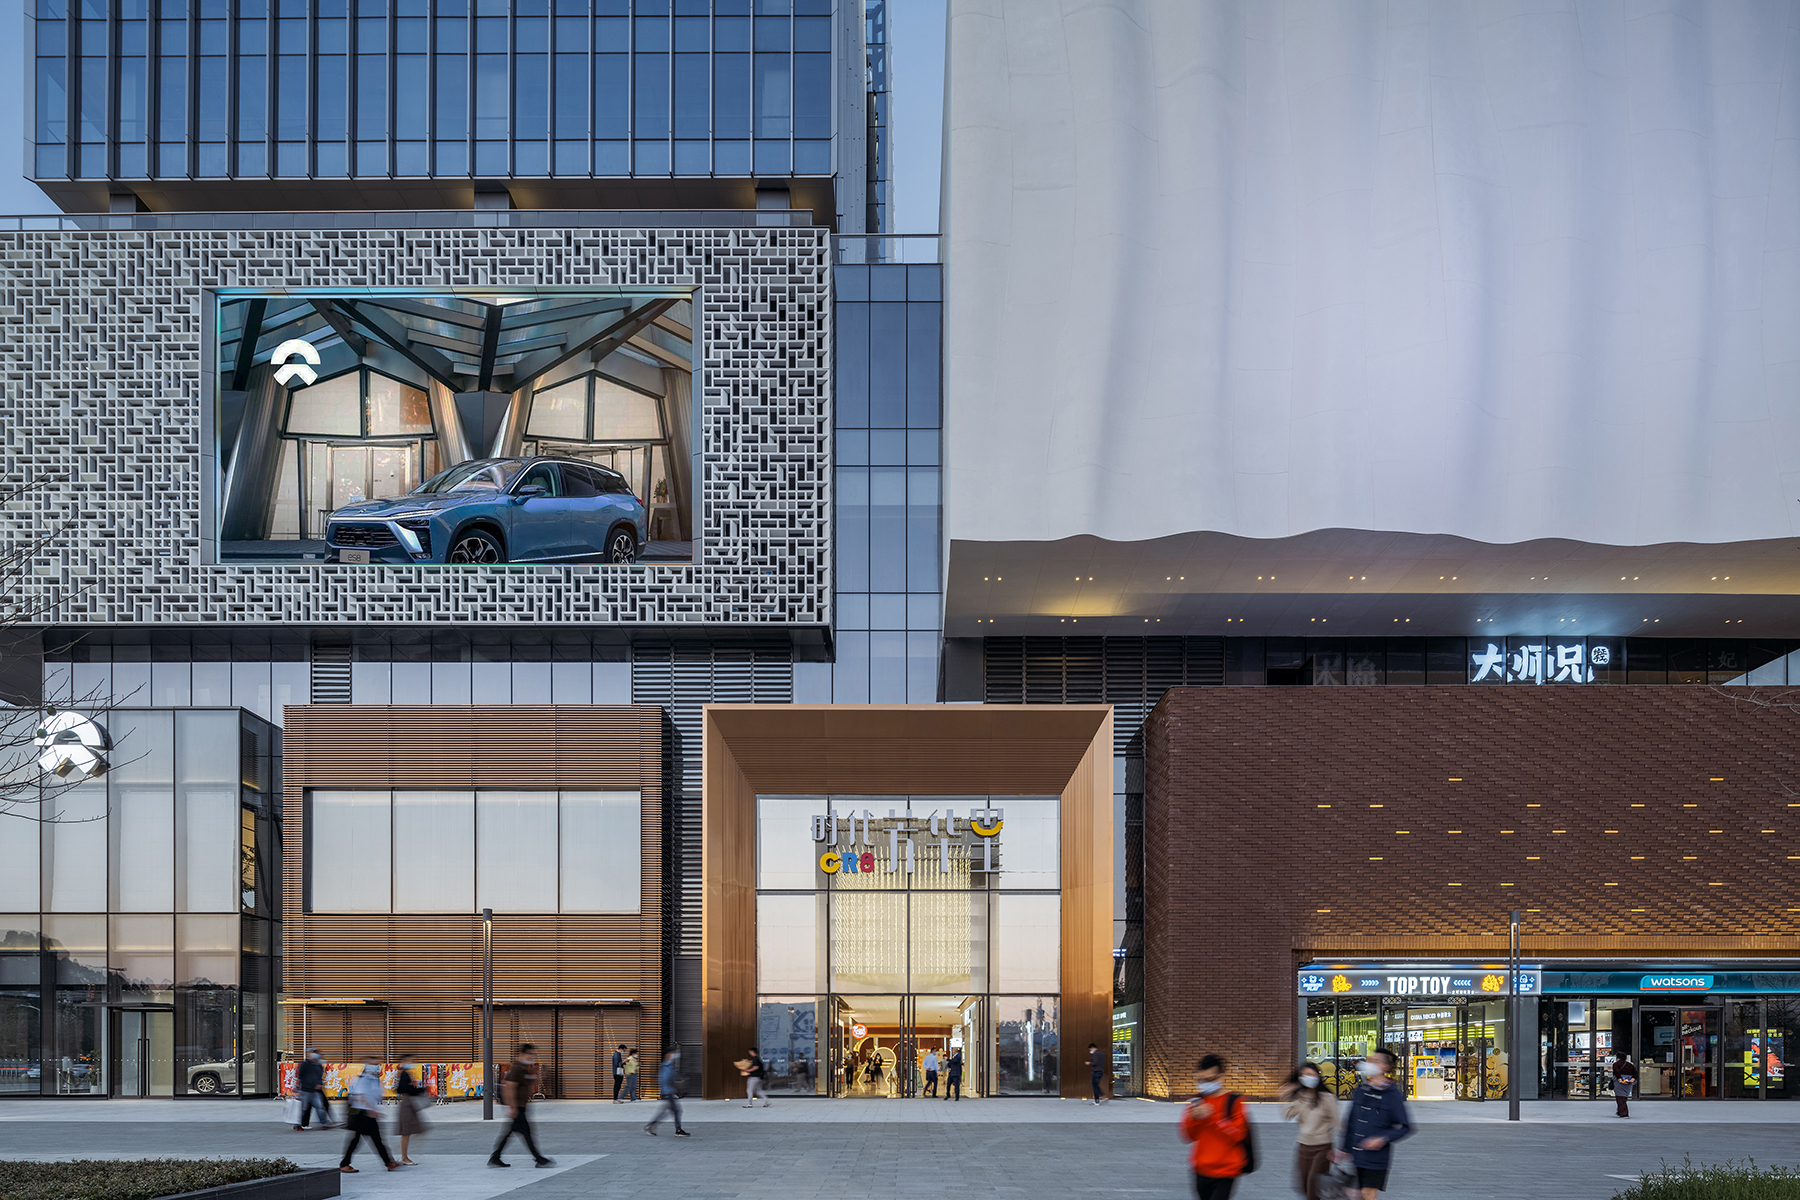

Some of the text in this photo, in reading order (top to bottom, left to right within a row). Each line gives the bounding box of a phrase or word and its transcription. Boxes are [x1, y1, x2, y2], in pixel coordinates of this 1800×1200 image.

[1472, 643, 1595, 685] 大师兄
[1387, 976, 1451, 995] TOP TOY
[1650, 976, 1705, 987] watsons
